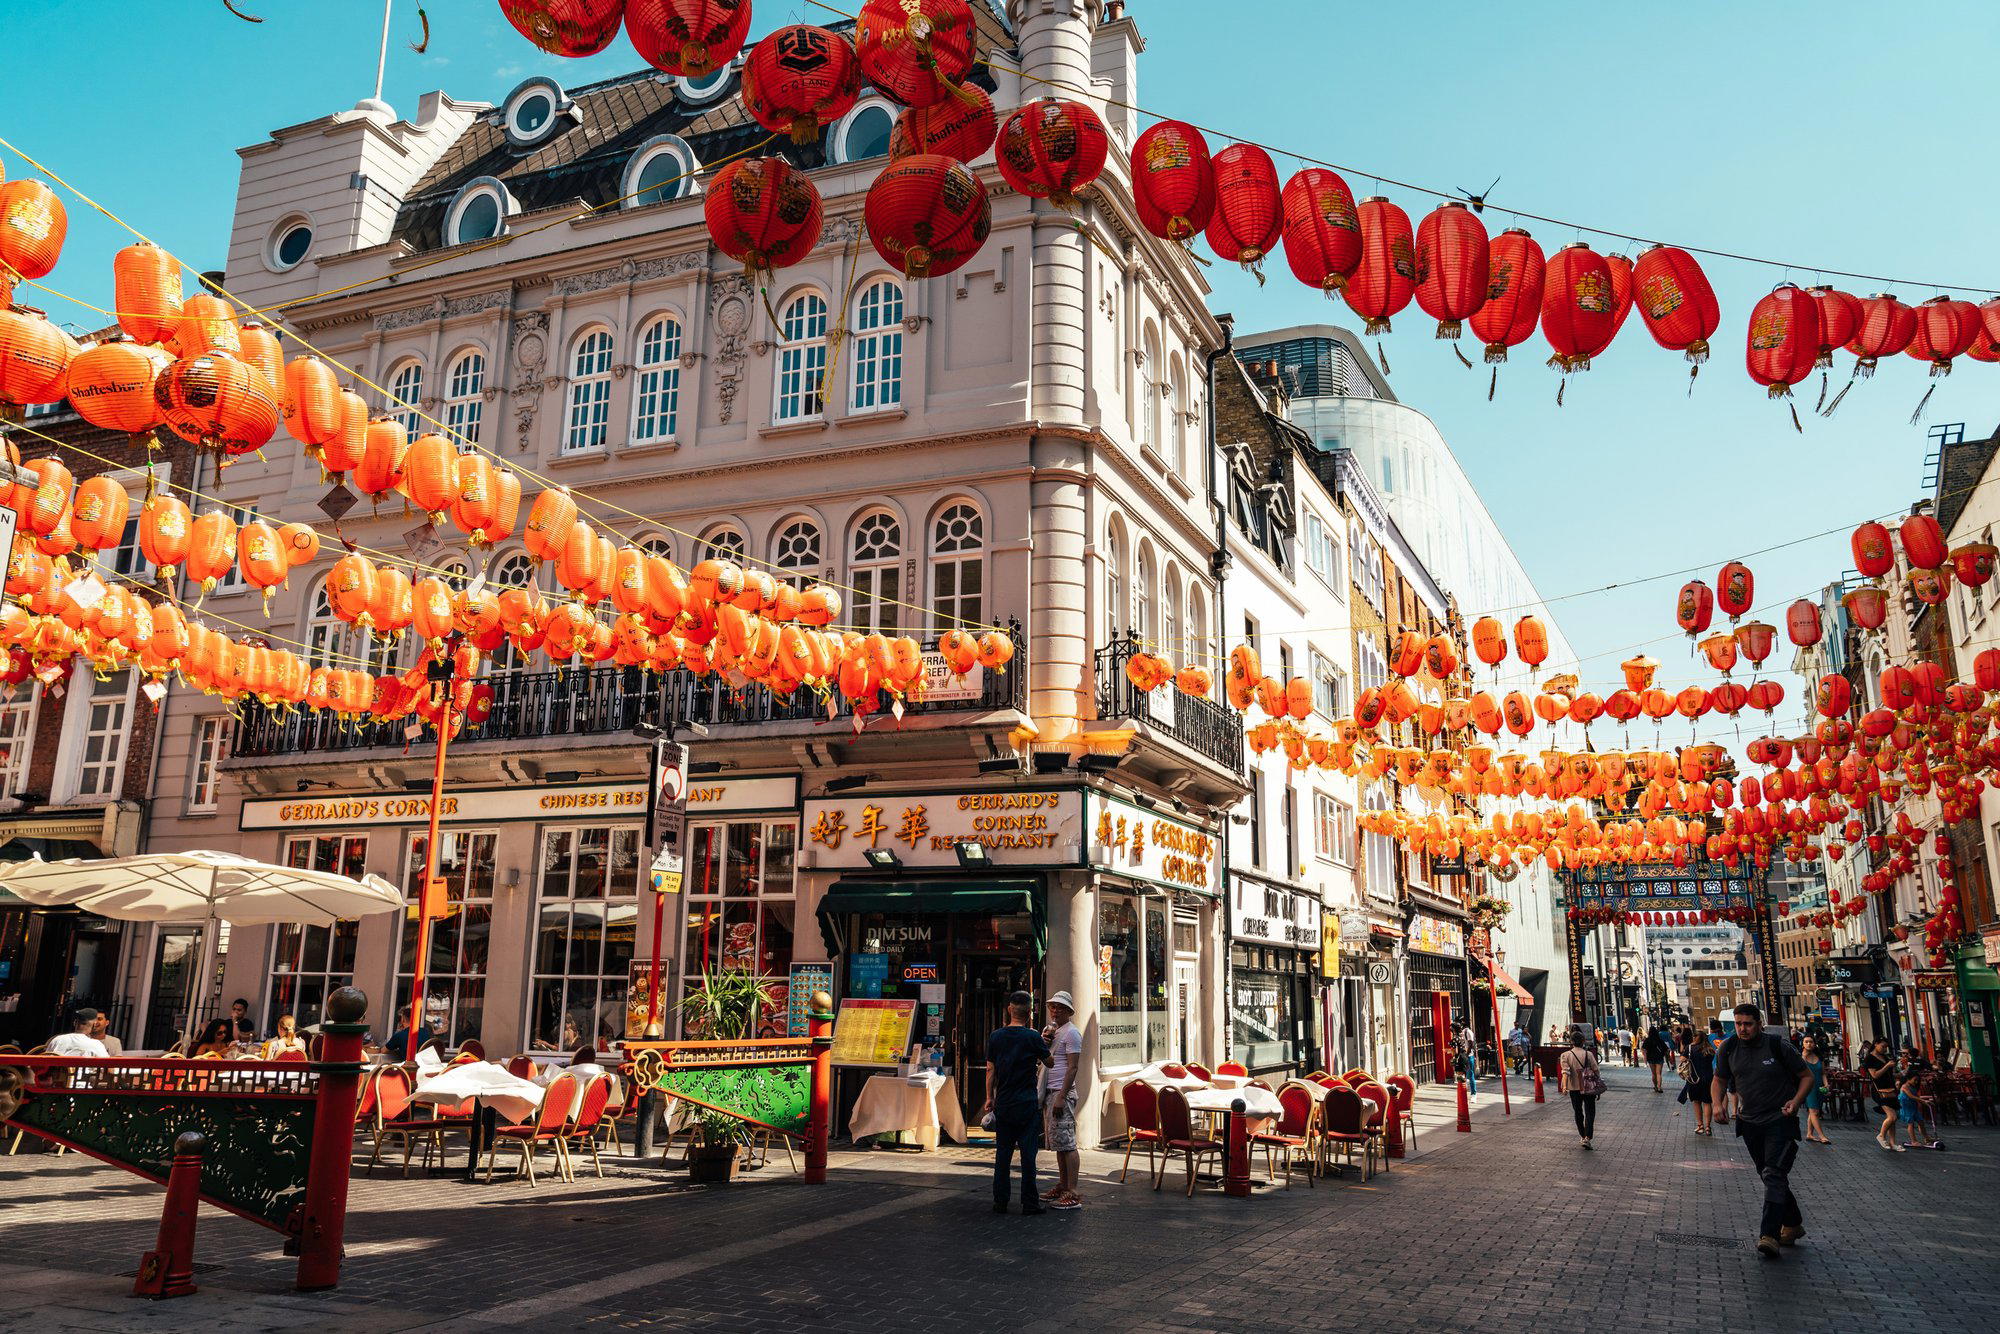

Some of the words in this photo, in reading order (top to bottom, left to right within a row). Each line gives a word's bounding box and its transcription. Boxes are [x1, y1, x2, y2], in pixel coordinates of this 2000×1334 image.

[781, 79, 830, 94] COLAND
[71, 381, 144, 399] Shaftesbury
[664, 751, 682, 764] ZONE
[539, 791, 608, 810] CHINESE
[956, 792, 1060, 811] GERRARD'S
[279, 800, 379, 822] GERRARD'S
[659, 822, 674, 830] loading
[809, 804, 929, 849] 好年華
[972, 814, 1047, 831] CORNER
[1152, 819, 1214, 863] GERRARD'S
[1162, 854, 1207, 889] CORNER
[868, 927, 895, 940] DIM
[900, 926, 931, 941] SUM
[904, 968, 936, 979] OPEN
[1238, 990, 1252, 1006] HOT
[1254, 990, 1278, 1006] BUFFET
